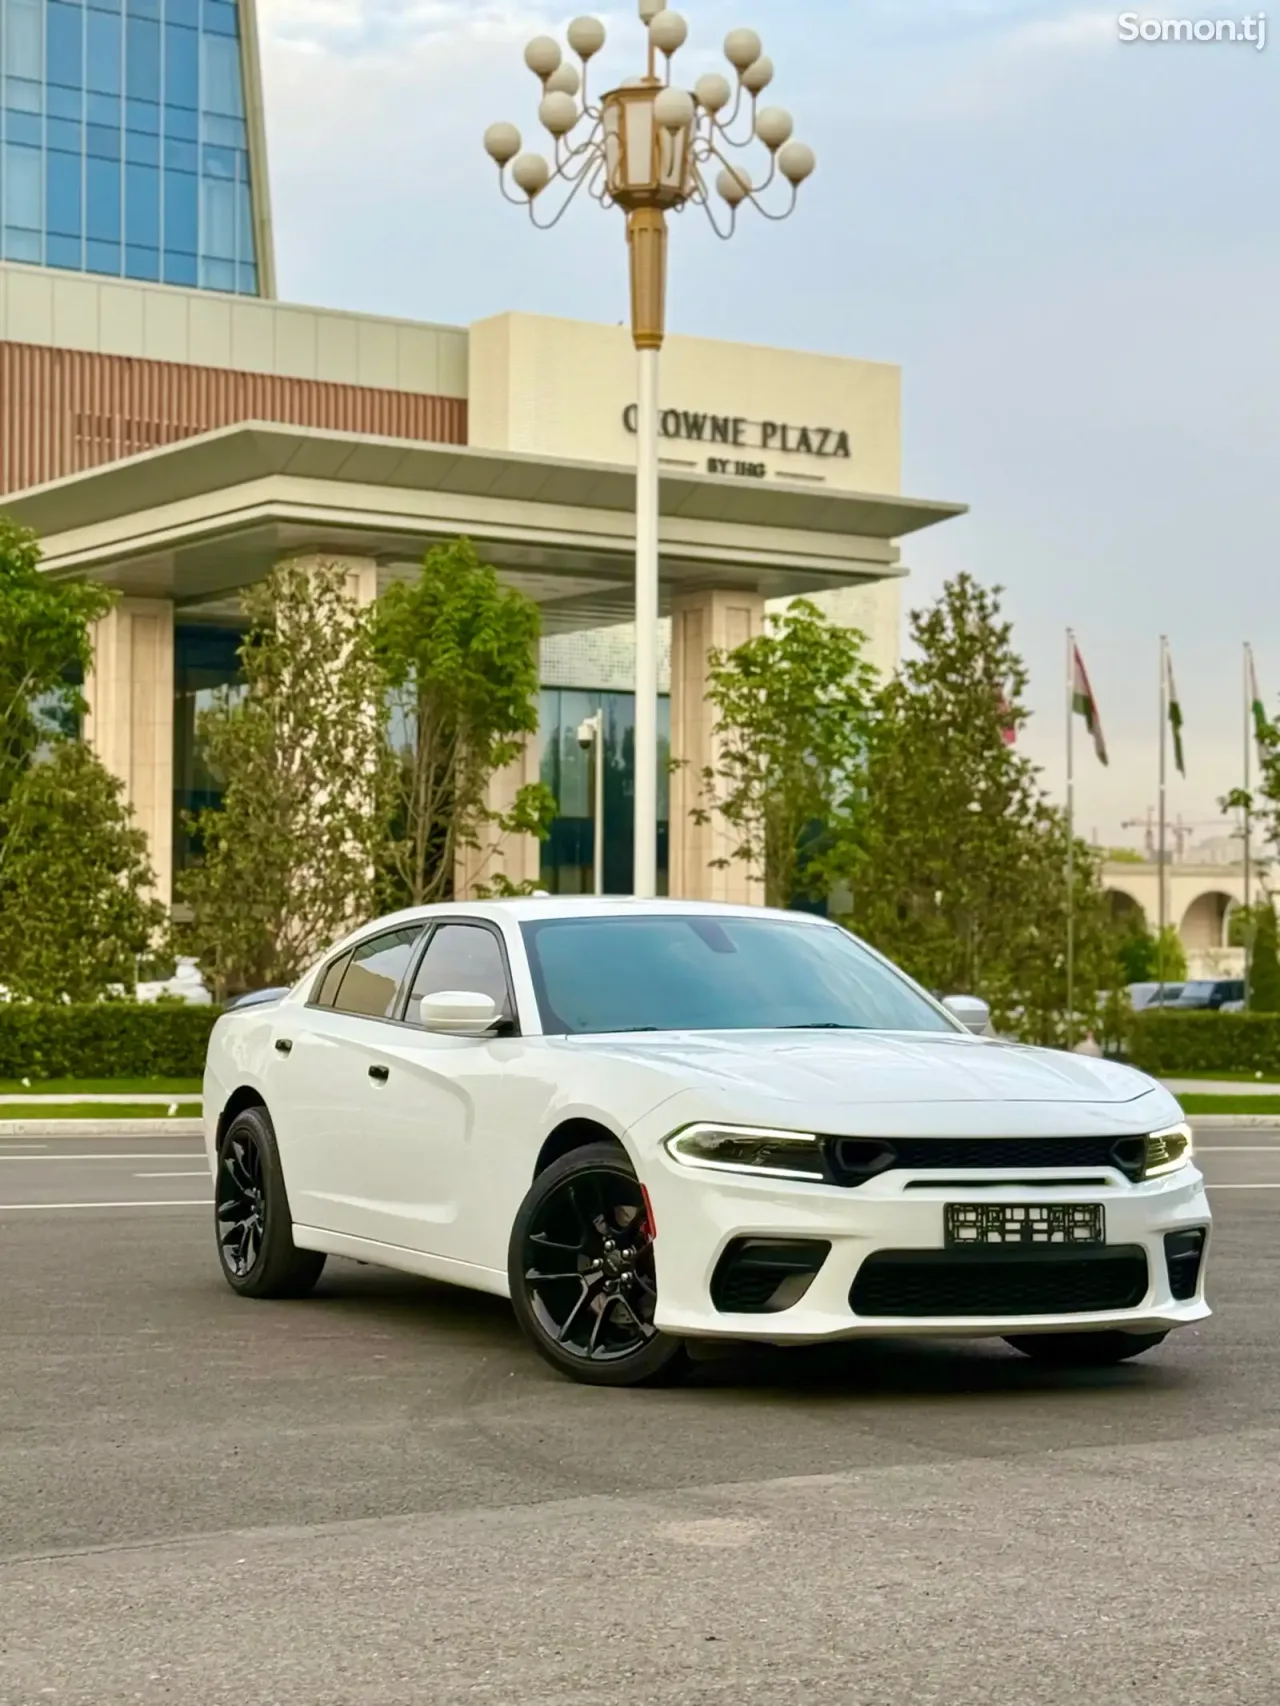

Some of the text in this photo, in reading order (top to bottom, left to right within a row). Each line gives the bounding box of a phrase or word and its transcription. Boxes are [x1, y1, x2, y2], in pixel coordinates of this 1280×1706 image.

[622, 403, 851, 457] COWNE PLAZA
[707, 457, 731, 474] BY
